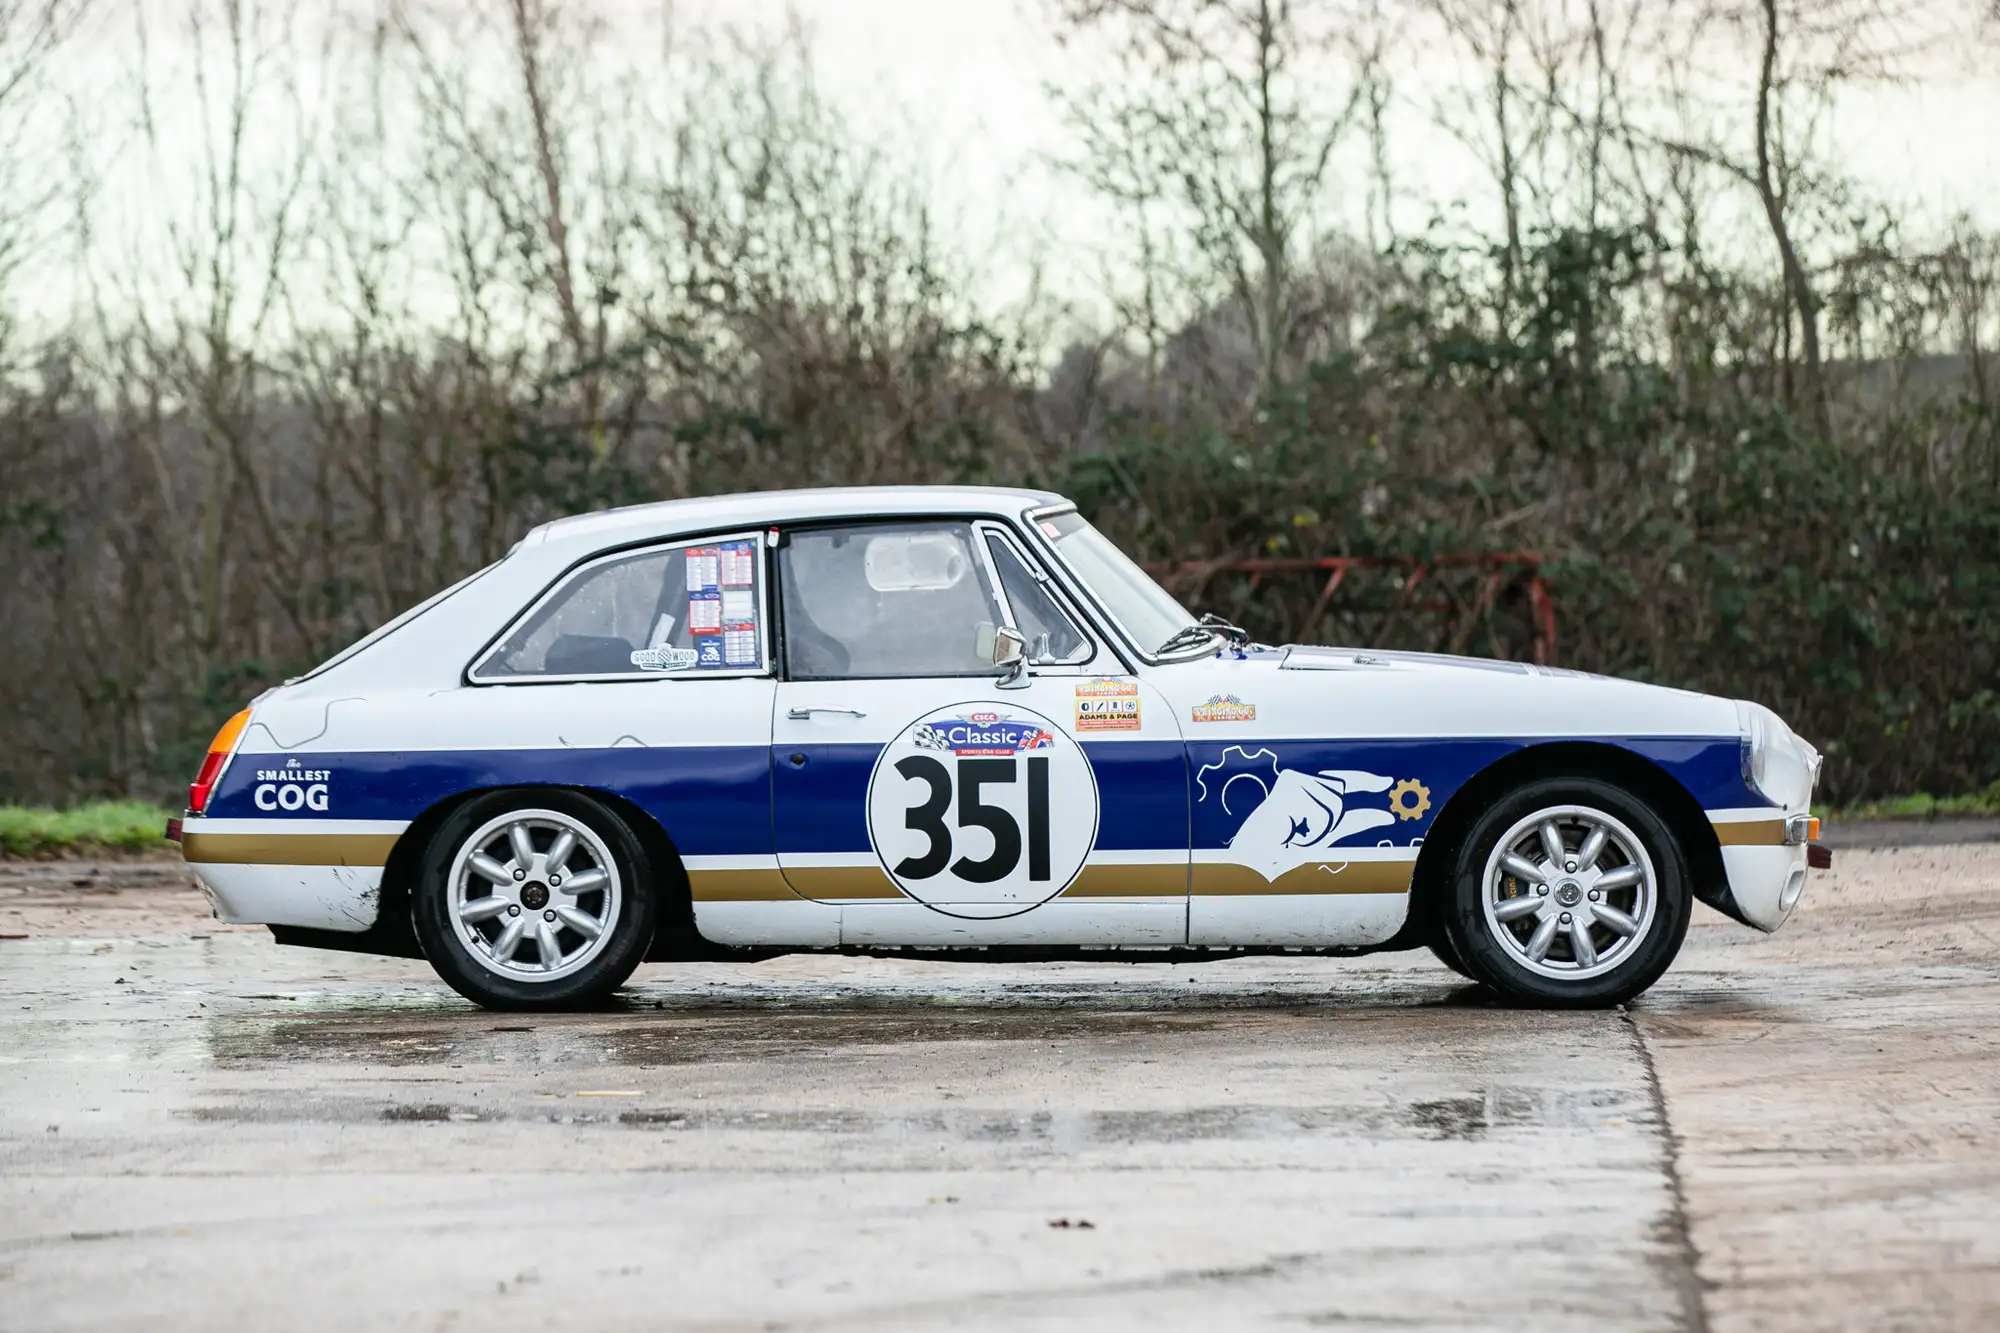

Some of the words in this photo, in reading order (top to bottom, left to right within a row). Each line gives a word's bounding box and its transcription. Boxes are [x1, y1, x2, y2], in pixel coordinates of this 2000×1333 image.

[948, 727, 1017, 744] Classic
[256, 770, 331, 781] SMALLEST
[254, 783, 329, 811] COG
[893, 755, 1051, 884] 351
